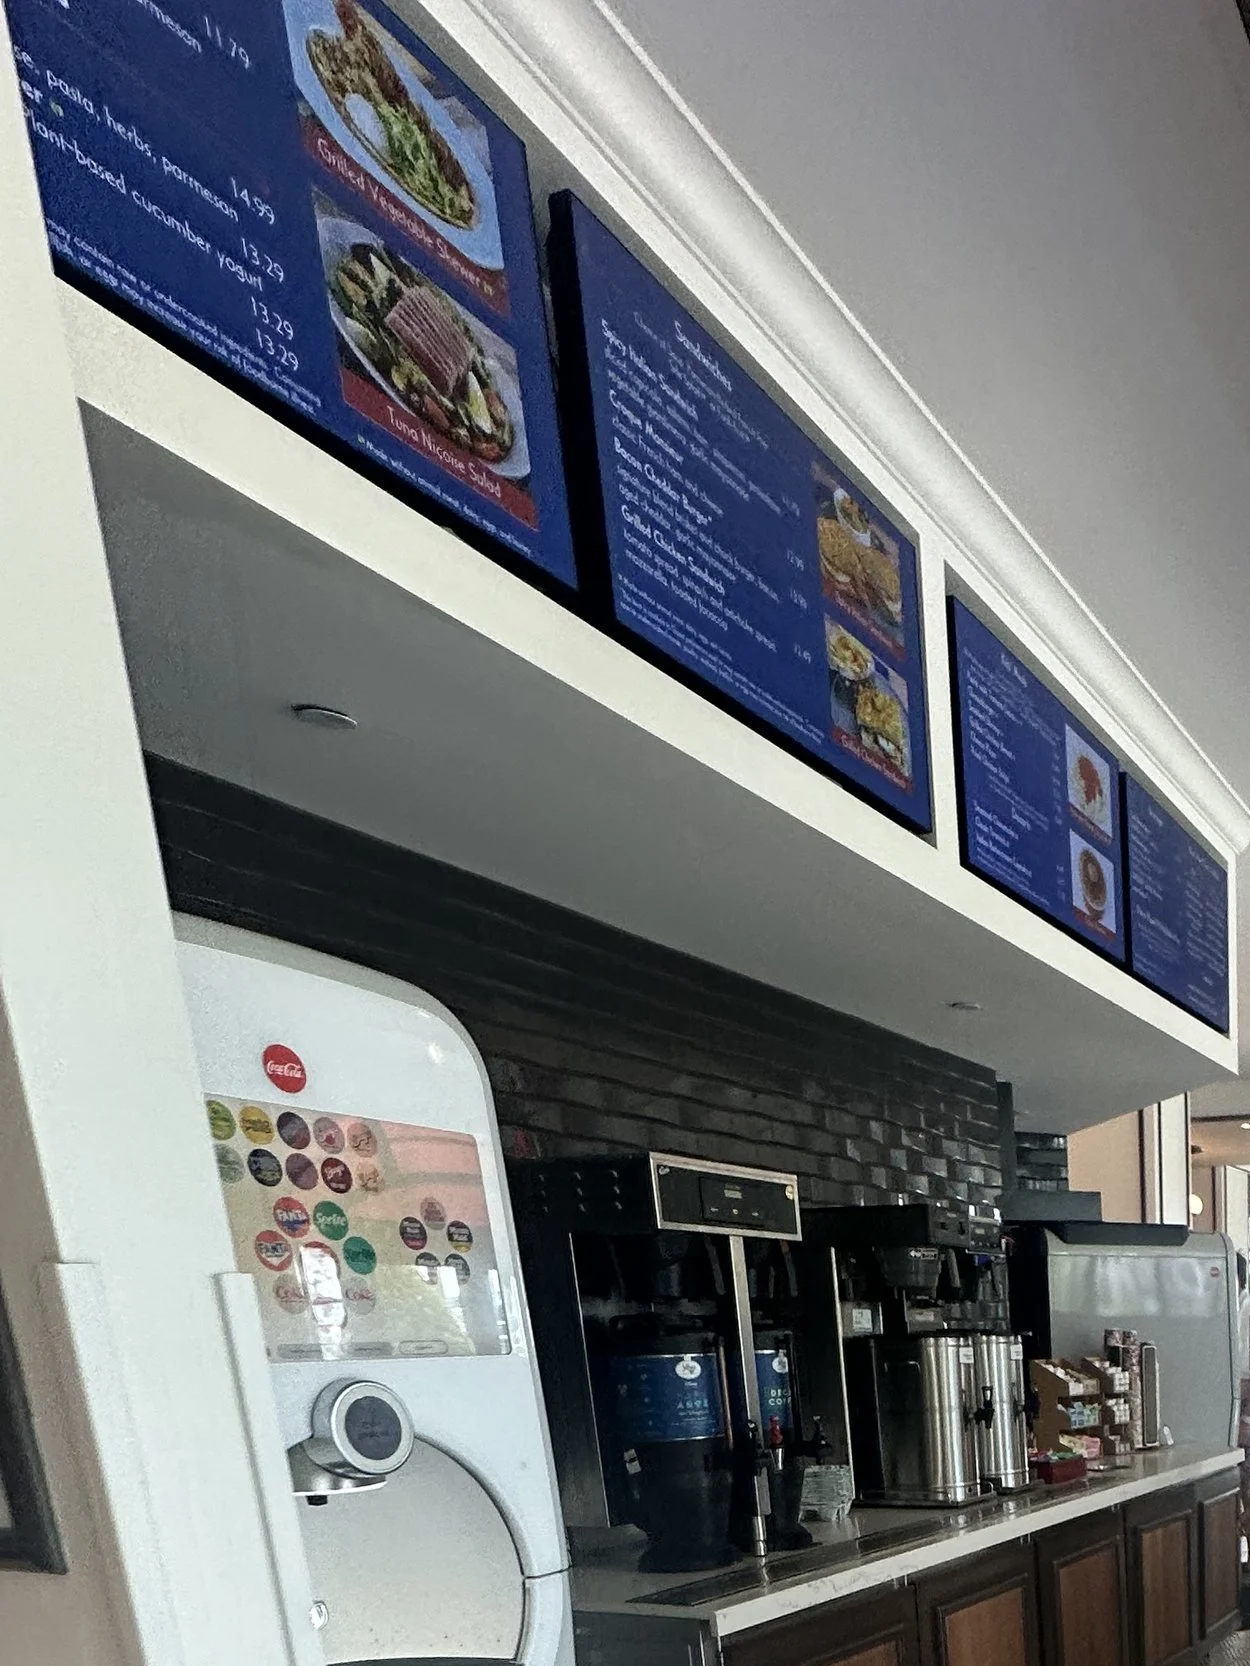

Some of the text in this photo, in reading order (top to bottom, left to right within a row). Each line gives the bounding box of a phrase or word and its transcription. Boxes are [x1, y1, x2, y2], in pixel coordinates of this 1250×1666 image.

[46, 69, 100, 121] pasta,
[104, 104, 157, 164] herbs,
[162, 156, 238, 222] parmesan
[231, 177, 275, 224] 14.99
[131, 190, 211, 254] cucumber
[217, 250, 264, 292] yogurt
[241, 237, 285, 283] 13.29
[316, 138, 481, 287] Grilled Vegetable Skewer
[251, 296, 294, 341] 13.29
[255, 327, 299, 371] 13.29
[675, 320, 731, 391] Sandwiches
[602, 319, 625, 356] Spicy
[629, 346, 656, 382] Italian
[659, 374, 697, 420] Sandwich
[387, 405, 502, 498] Tuna Niçoise Salad
[609, 387, 641, 431] Croque
[645, 420, 683, 465] Monsieur
[614, 436, 641, 471] Bacon
[644, 462, 679, 503] Cheddar
[638, 435, 665, 467] French
[685, 475, 698, 496] and
[621, 503, 651, 538] Grilled
[653, 528, 685, 564] Chicken
[688, 556, 724, 594] Sandwich
[623, 528, 651, 558] tomato
[315, 1213, 347, 1227] Sprite
